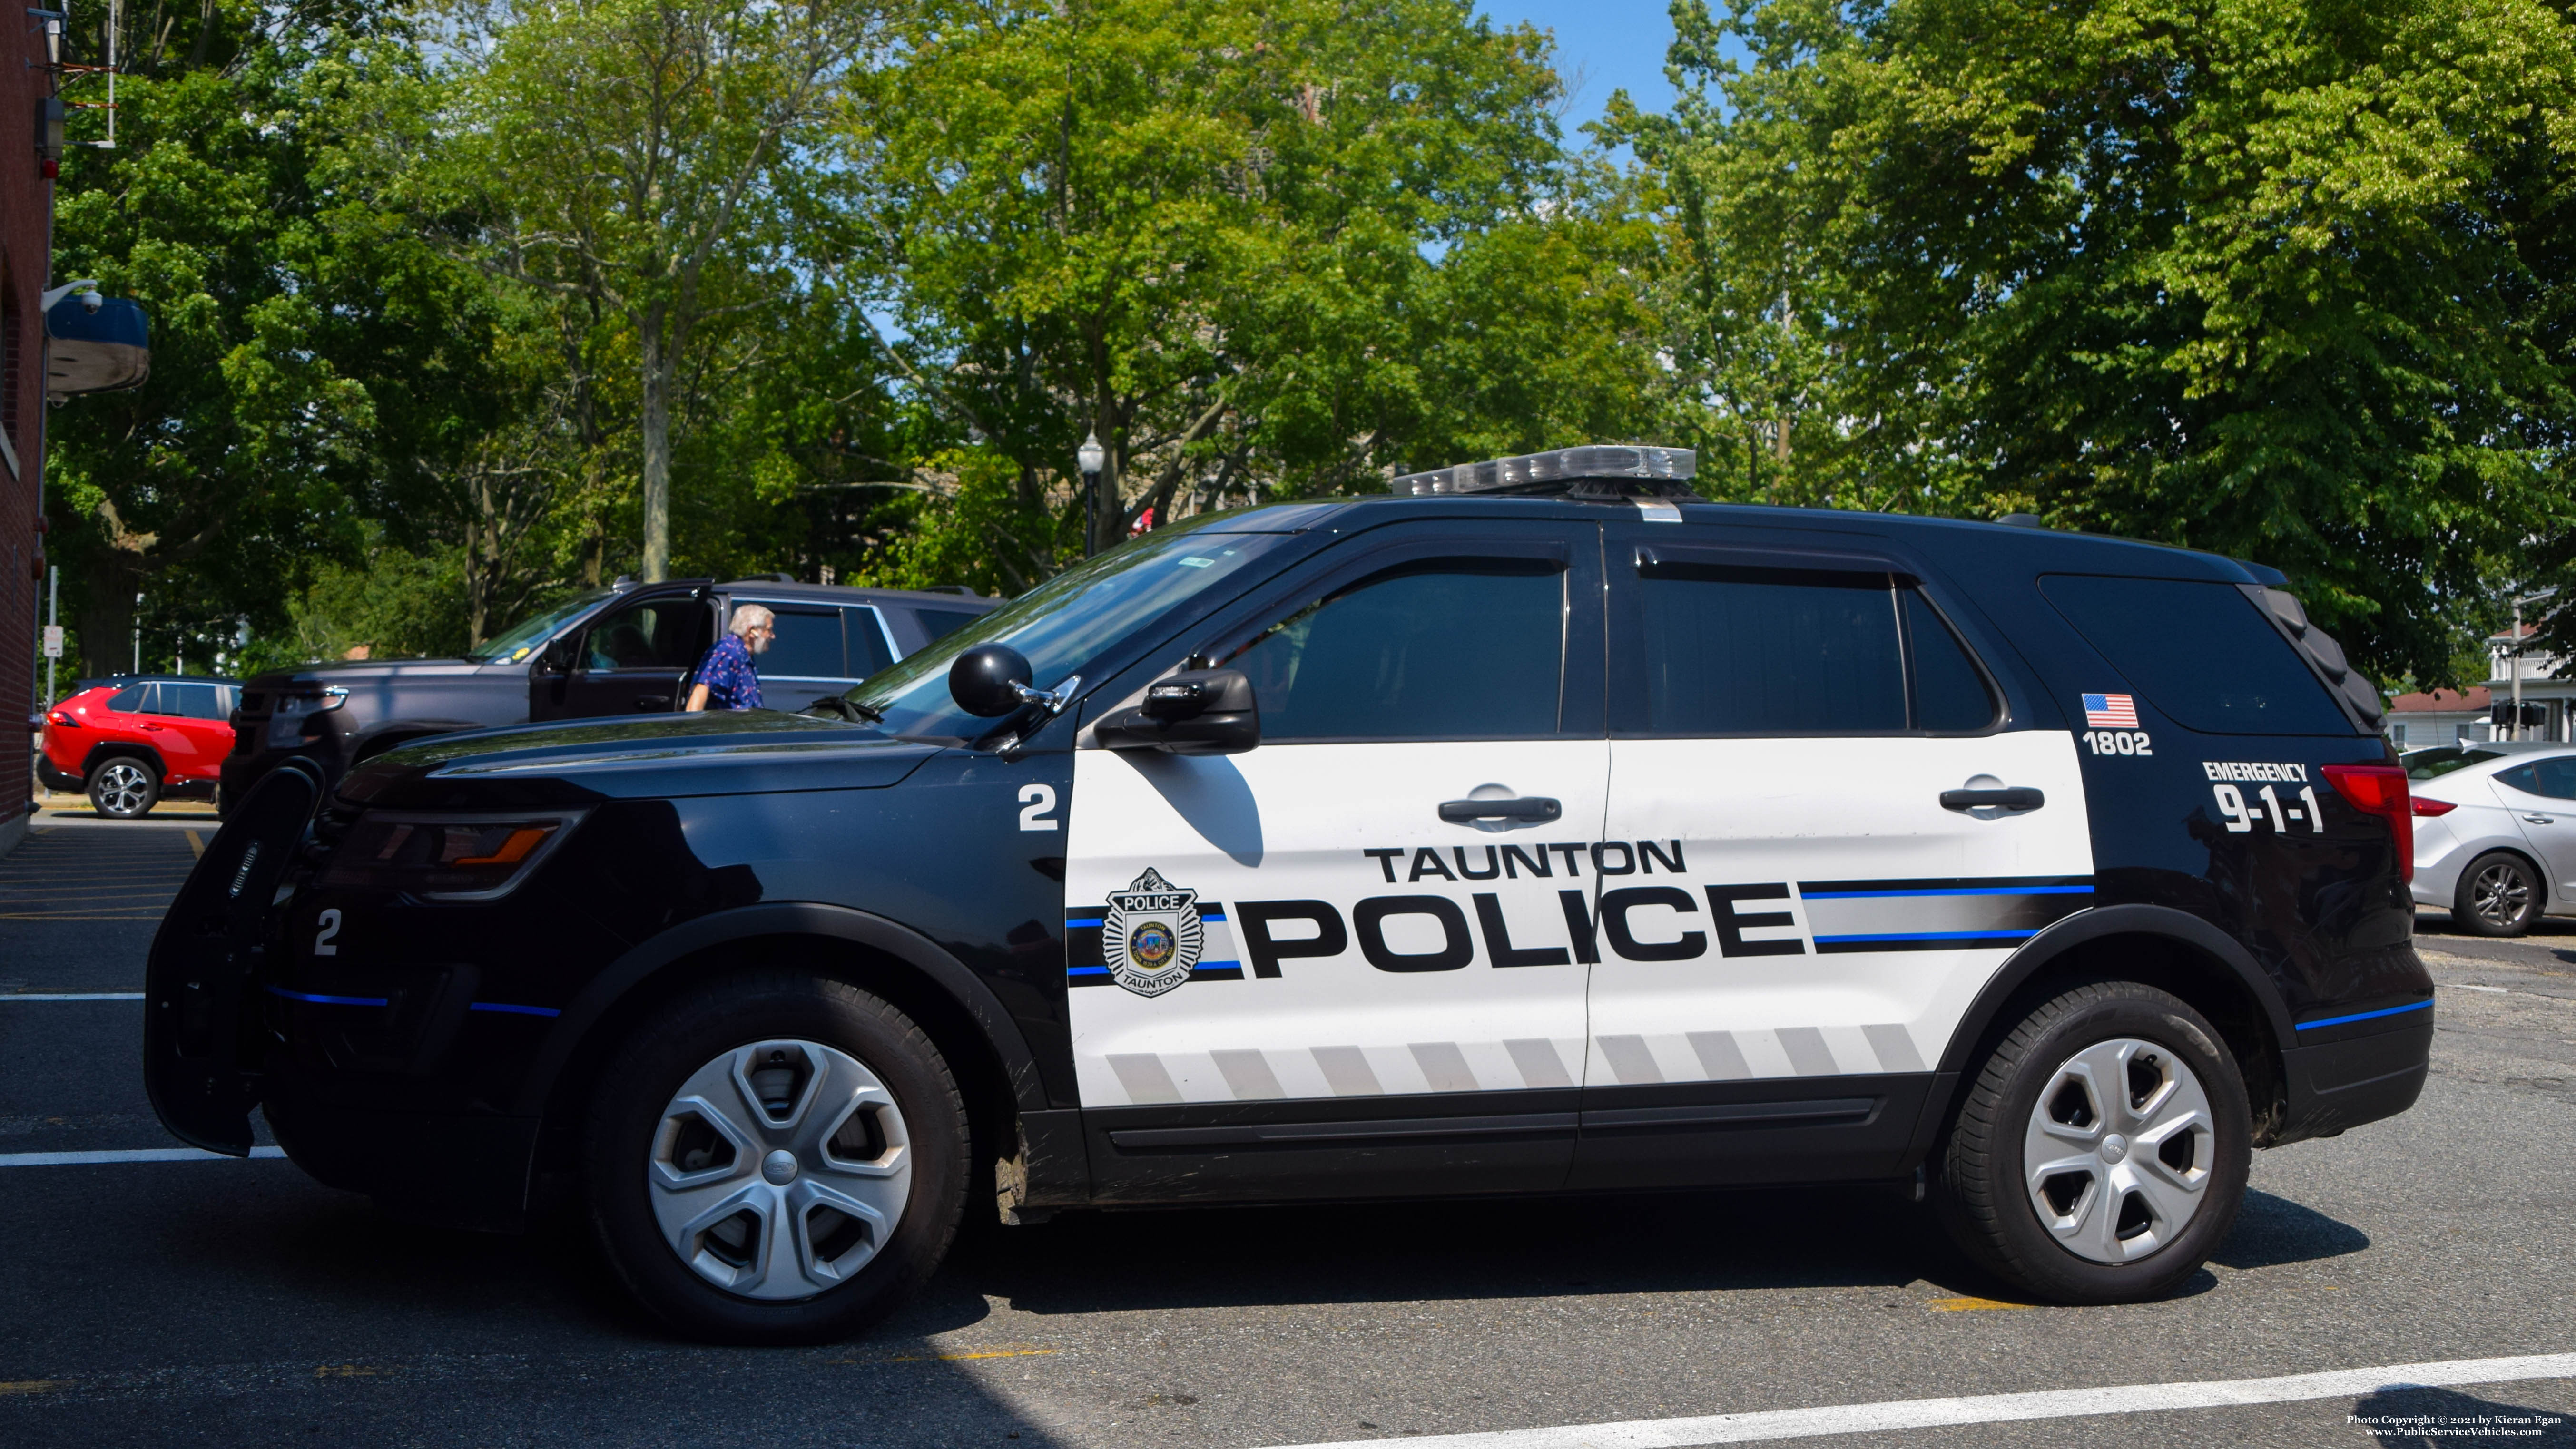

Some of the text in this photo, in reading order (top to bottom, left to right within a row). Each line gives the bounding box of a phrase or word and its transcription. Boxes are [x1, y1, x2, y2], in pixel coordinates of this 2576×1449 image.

[2082, 731, 2153, 755] 1802
[2202, 762, 2308, 782] EMERGENCY
[1018, 783, 1058, 831] 2
[2213, 784, 2323, 832] 9-1-1
[1363, 840, 1687, 884] TAUNTON
[1124, 895, 1180, 911] POLICE
[315, 908, 342, 956] 2
[1140, 923, 1165, 931] TAUNTON
[1234, 881, 1807, 979] POLICE
[1123, 972, 1183, 989] TAUNTON
